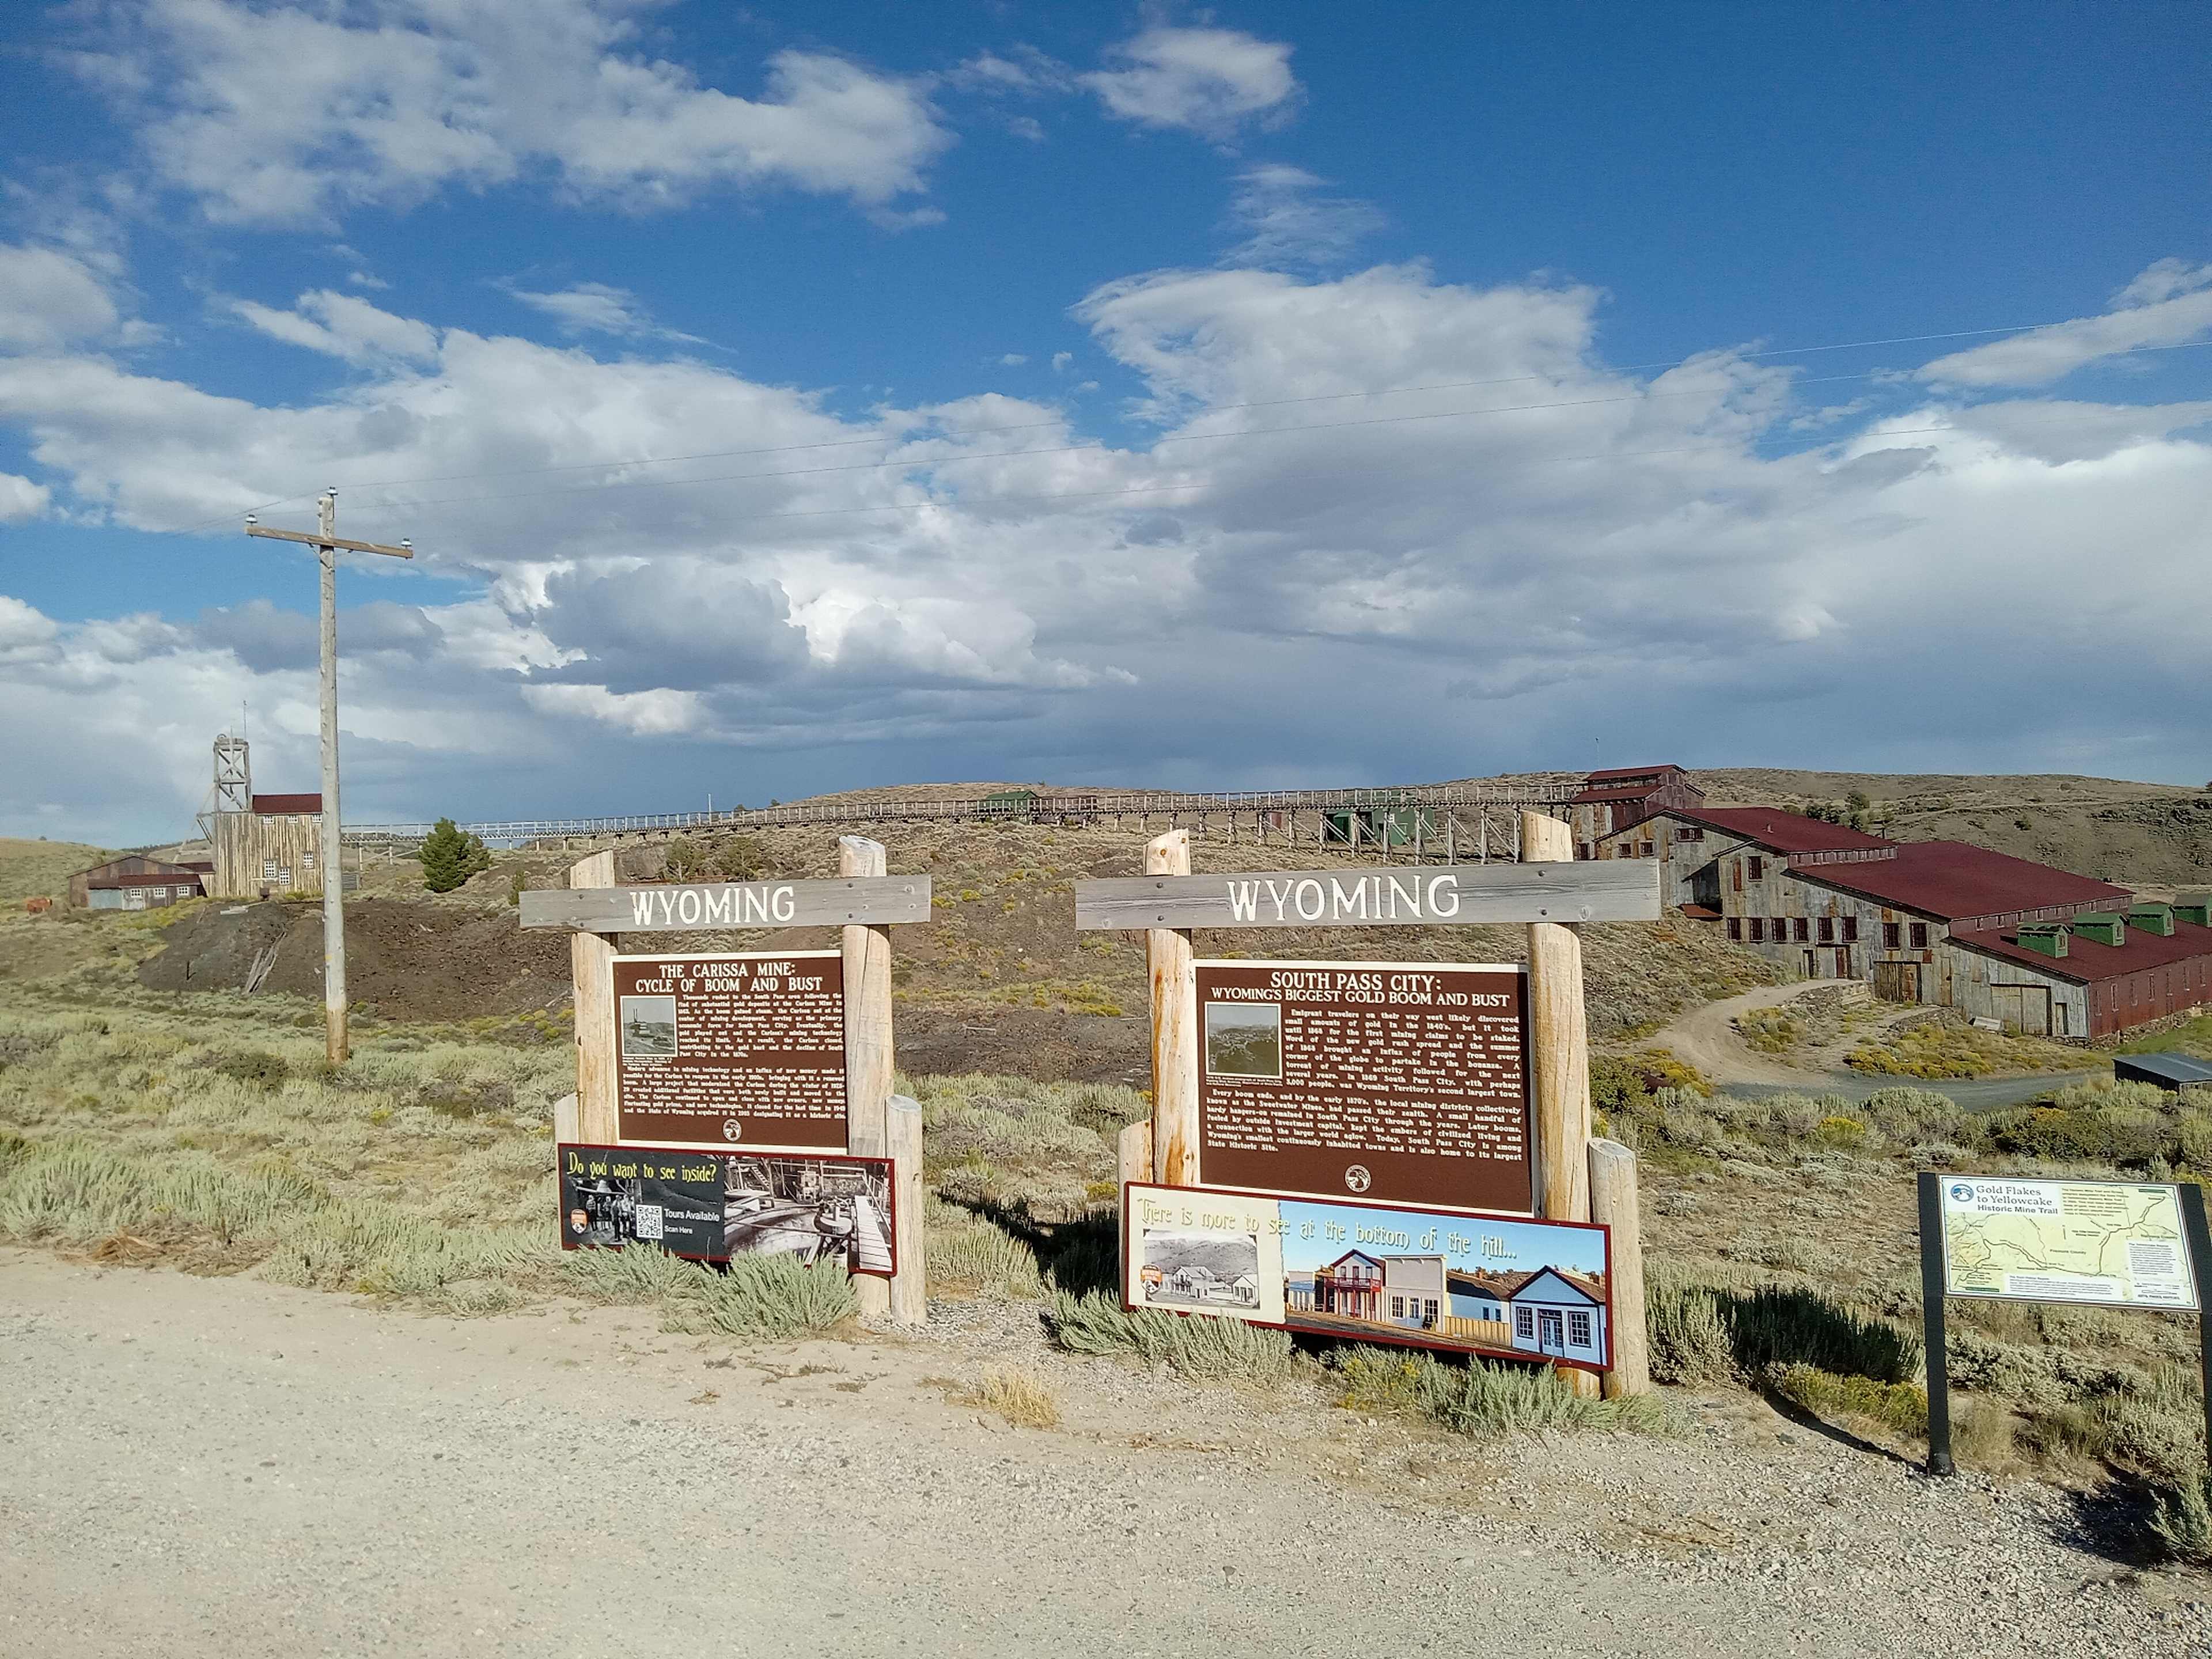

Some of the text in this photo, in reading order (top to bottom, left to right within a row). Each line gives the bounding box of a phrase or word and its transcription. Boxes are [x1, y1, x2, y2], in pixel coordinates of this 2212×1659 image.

[1225, 875, 1459, 920] WYOMING
[629, 887, 794, 925] WYOMING
[658, 961, 795, 978] THE CARISSA MINE:
[635, 976, 823, 993] CYCLE OF BOOM AND BUST
[1270, 971, 1441, 991] SOUTH PASS CITY:
[1210, 987, 1510, 1006] WYOMING'S BIGGEST GOLD BOOM AND BUST
[1291, 1009, 1322, 1017] Emigrant
[1448, 1014, 1471, 1022] likely
[1365, 1020, 1381, 1028] gold
[1323, 1045, 1352, 1054] brought
[1338, 1064, 1363, 1073] mining
[1372, 1066, 1403, 1074] activity
[1412, 1067, 1445, 1075] followed
[1467, 1060, 1502, 1069] bonanza.
[1355, 1082, 1389, 1091] Wyoming
[1467, 1088, 1495, 1097] largest
[1489, 1081, 1520, 1089] perhaps
[1474, 1113, 1505, 1122] handful
[1229, 1141, 1257, 1150] Historic
[1365, 1142, 1386, 1150] towns
[1420, 1146, 1435, 1154] also
[1440, 1148, 1461, 1156] home
[1493, 1152, 1522, 1161] largest
[566, 1151, 717, 1183] Do you want to see inside?
[1976, 1185, 2042, 1196] Gold Flakes
[1990, 1195, 2052, 1206] Yellowcake
[663, 1208, 719, 1221] Tours Available
[1978, 1204, 2013, 1213] Historic
[2037, 1207, 2058, 1215] Trail
[1137, 1198, 1172, 1224] There
[1181, 1207, 1193, 1225] is
[1202, 1212, 1236, 1231] more
[1244, 1213, 1260, 1232] to
[1268, 1217, 1290, 1236] see
[1300, 1219, 1315, 1240] at
[1324, 1219, 1346, 1244] the
[1355, 1222, 1410, 1250] bottom
[1419, 1226, 1437, 1251] of
[1446, 1232, 1471, 1257] the
